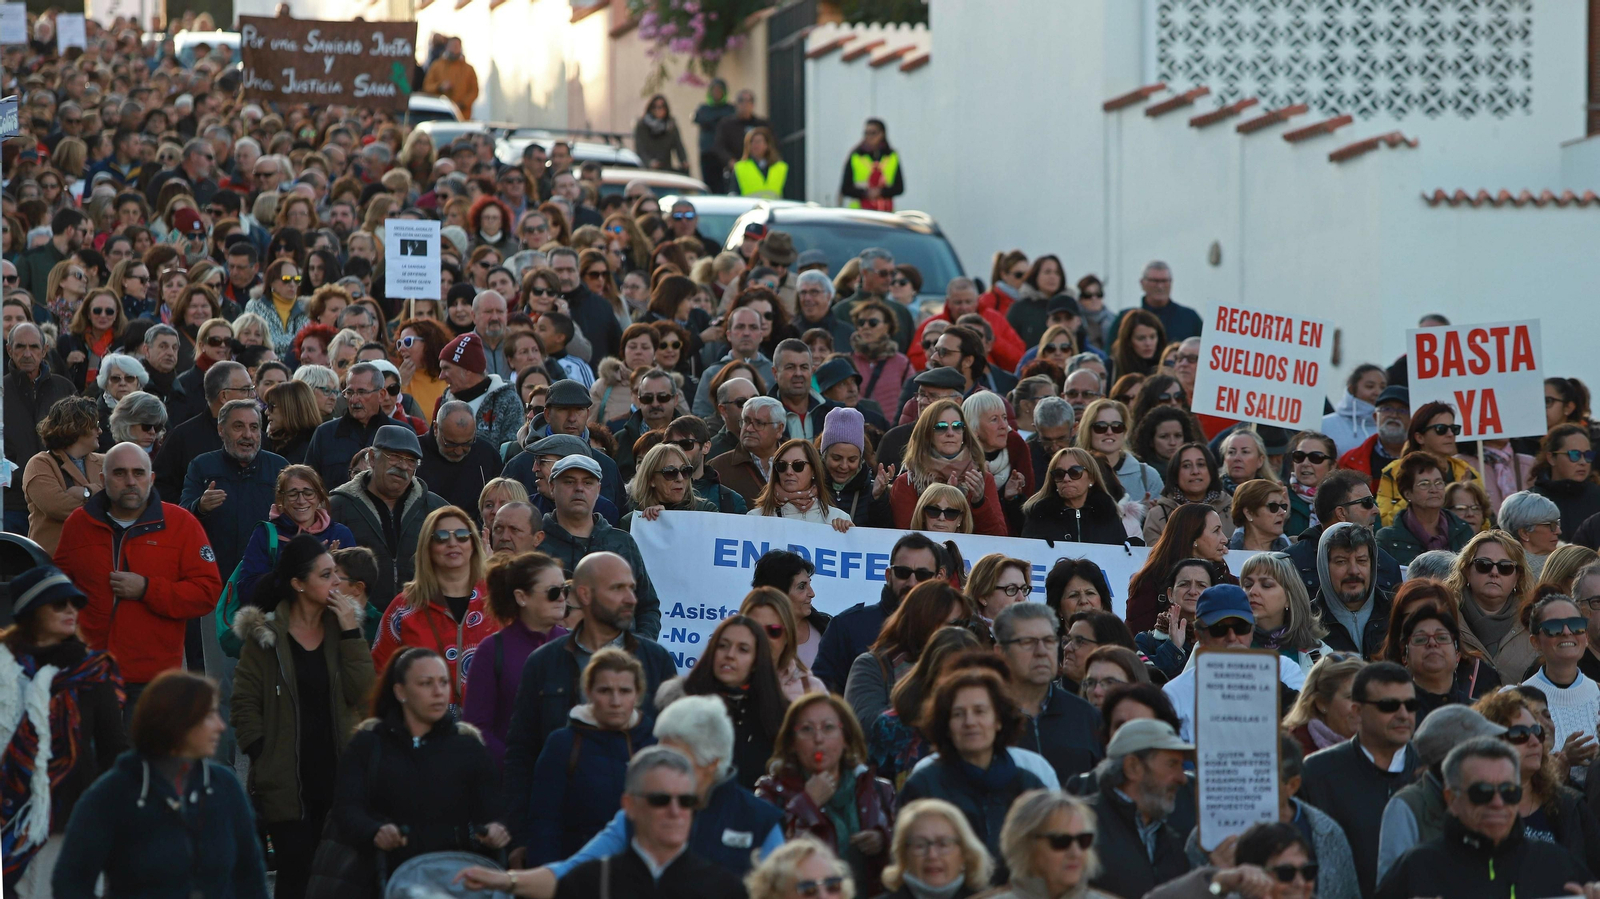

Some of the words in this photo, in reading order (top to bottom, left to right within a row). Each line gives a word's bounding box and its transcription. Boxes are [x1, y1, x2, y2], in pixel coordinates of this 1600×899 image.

[1215, 306, 1293, 344] RECORTA
[1298, 320, 1323, 348] EN
[452, 336, 471, 363] DUDE
[1209, 345, 1289, 382] SUELDOS
[1292, 359, 1319, 387] NO
[1415, 325, 1536, 379] BASTA
[1215, 385, 1240, 414] EN
[1244, 391, 1303, 424] SALUD
[1453, 388, 1503, 436] YA
[713, 538, 770, 569] EN
[663, 627, 700, 644] -No
